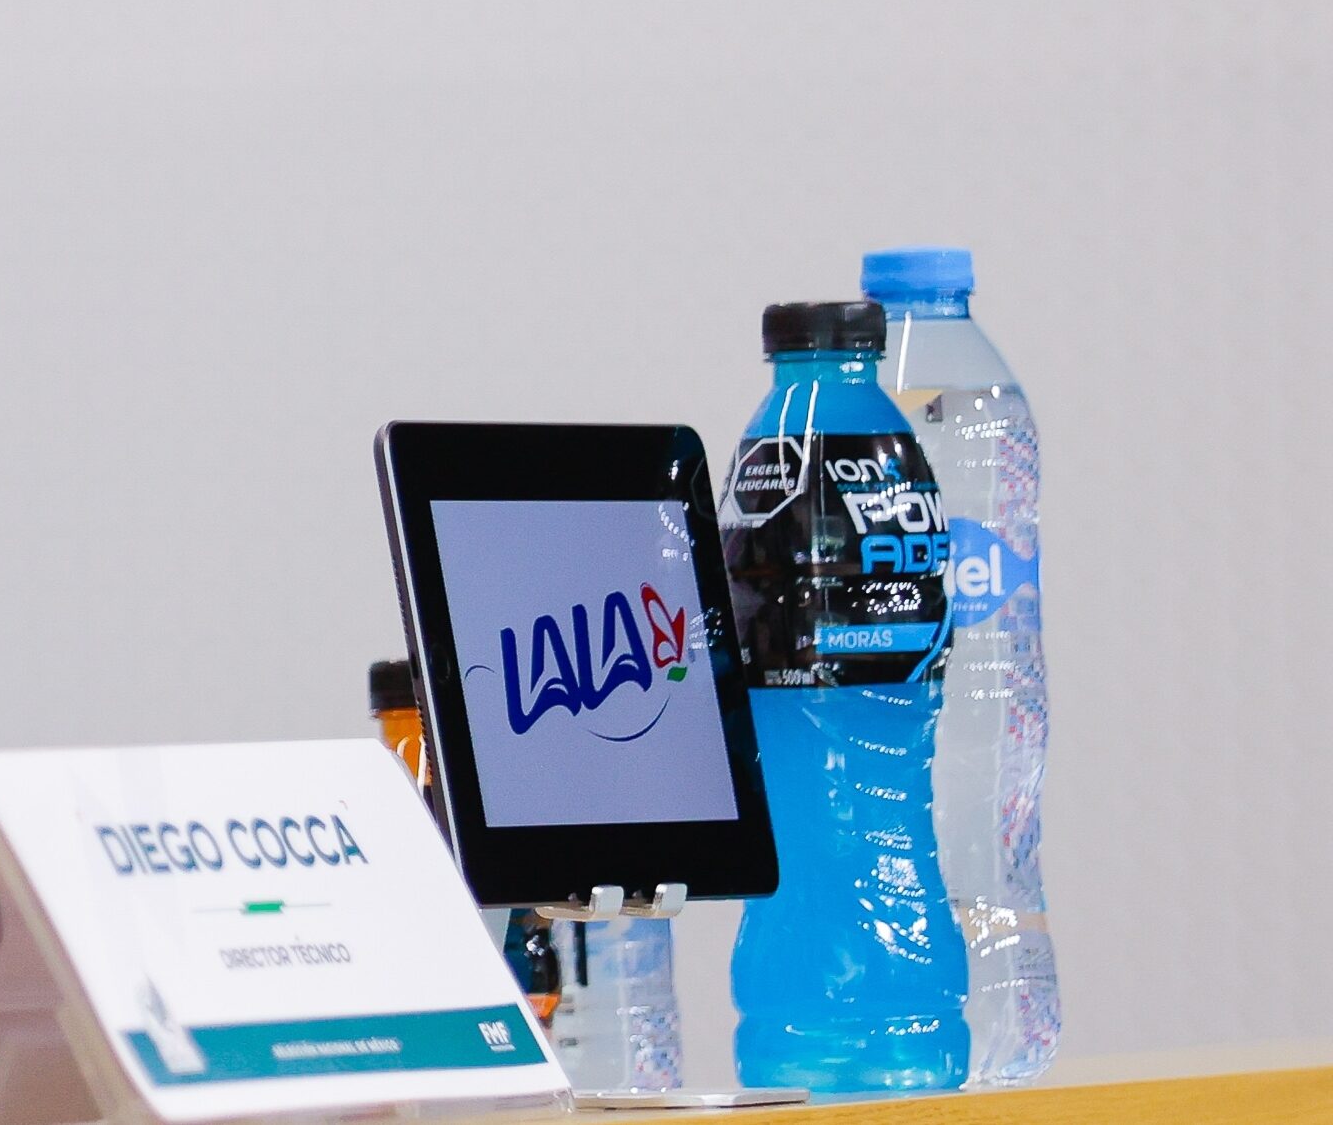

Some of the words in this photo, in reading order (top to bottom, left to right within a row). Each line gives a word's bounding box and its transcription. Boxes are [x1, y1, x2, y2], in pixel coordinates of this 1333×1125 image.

[942, 541, 1002, 597] iel
[500, 591, 653, 735] LALA
[828, 630, 894, 650] MORAS
[95, 820, 224, 875] DIEGO
[225, 814, 369, 868] COCCA
[218, 946, 289, 970] DIRECTOR
[289, 935, 352, 966] TÉCNICO
